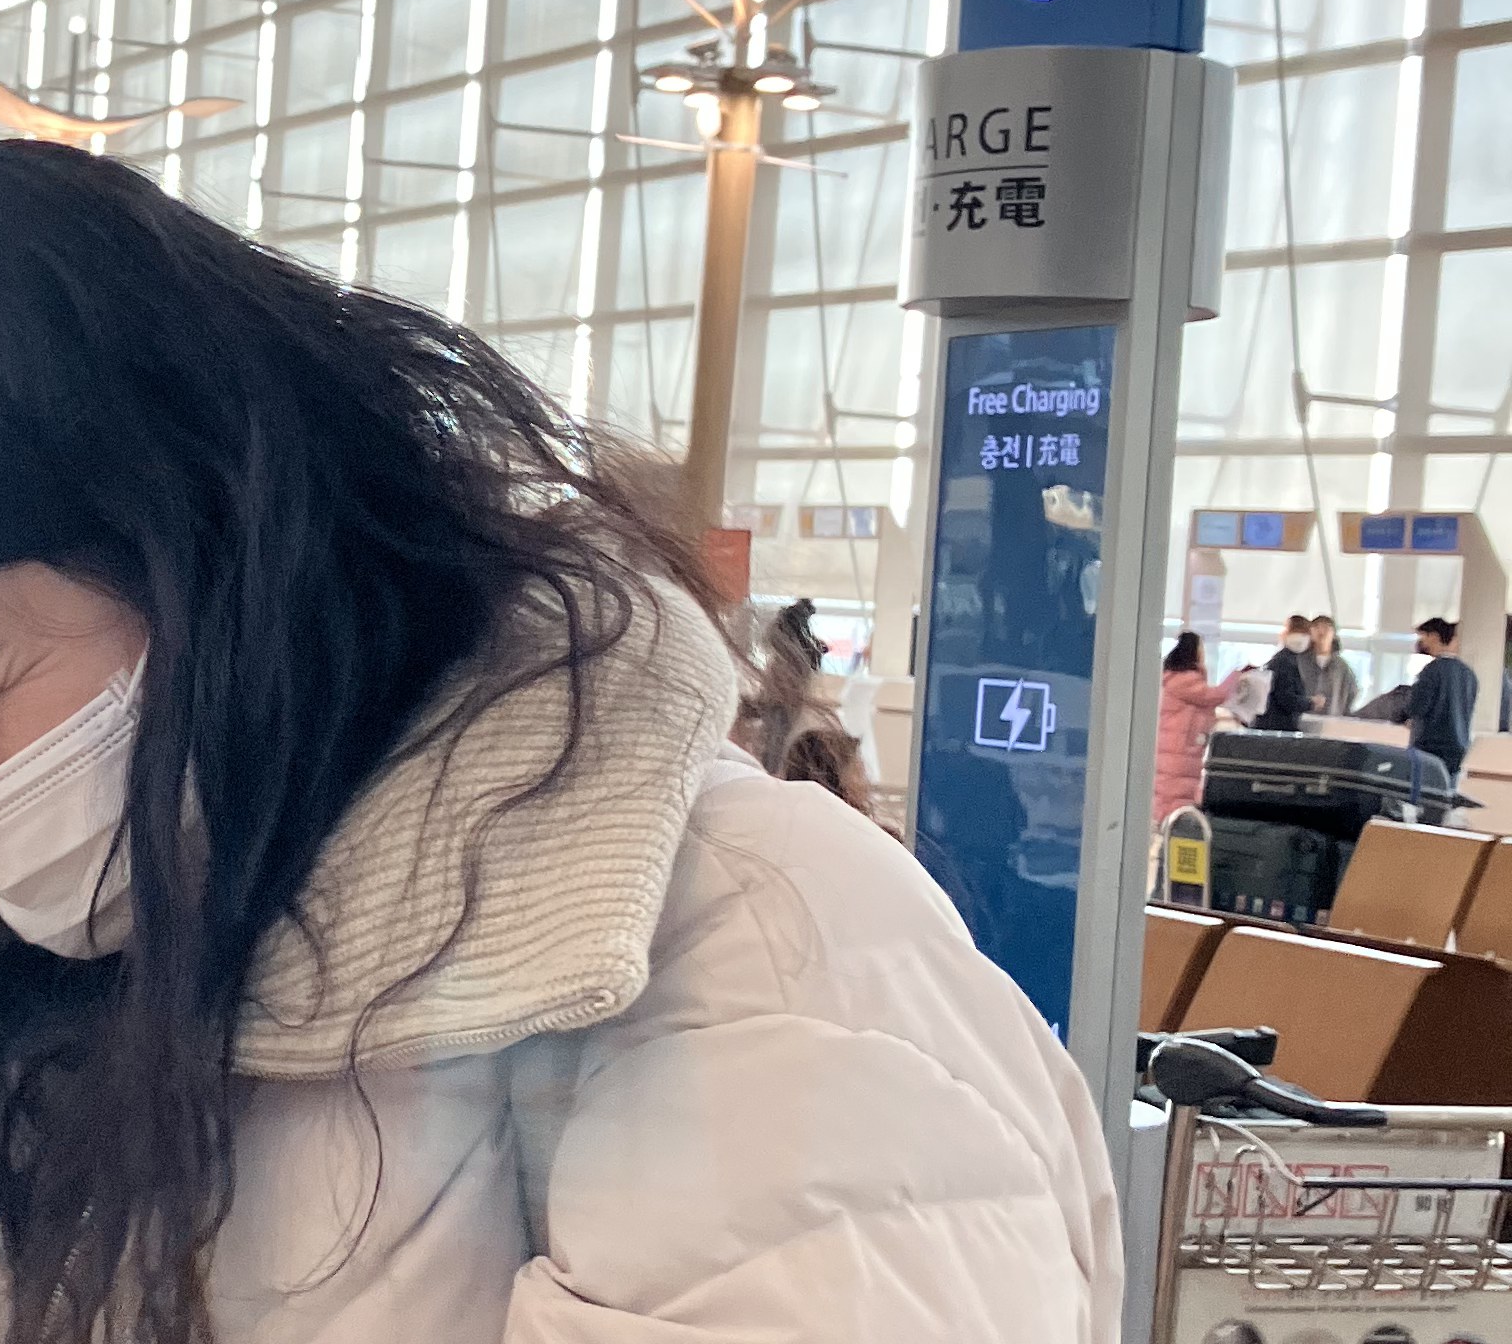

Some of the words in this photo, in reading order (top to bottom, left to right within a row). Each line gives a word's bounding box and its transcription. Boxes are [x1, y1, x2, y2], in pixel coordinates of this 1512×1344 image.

[968, 386, 1008, 416] Free
[1011, 382, 1101, 417] Charging
[979, 433, 1021, 470] 충전
[1037, 433, 1081, 466] 充電
